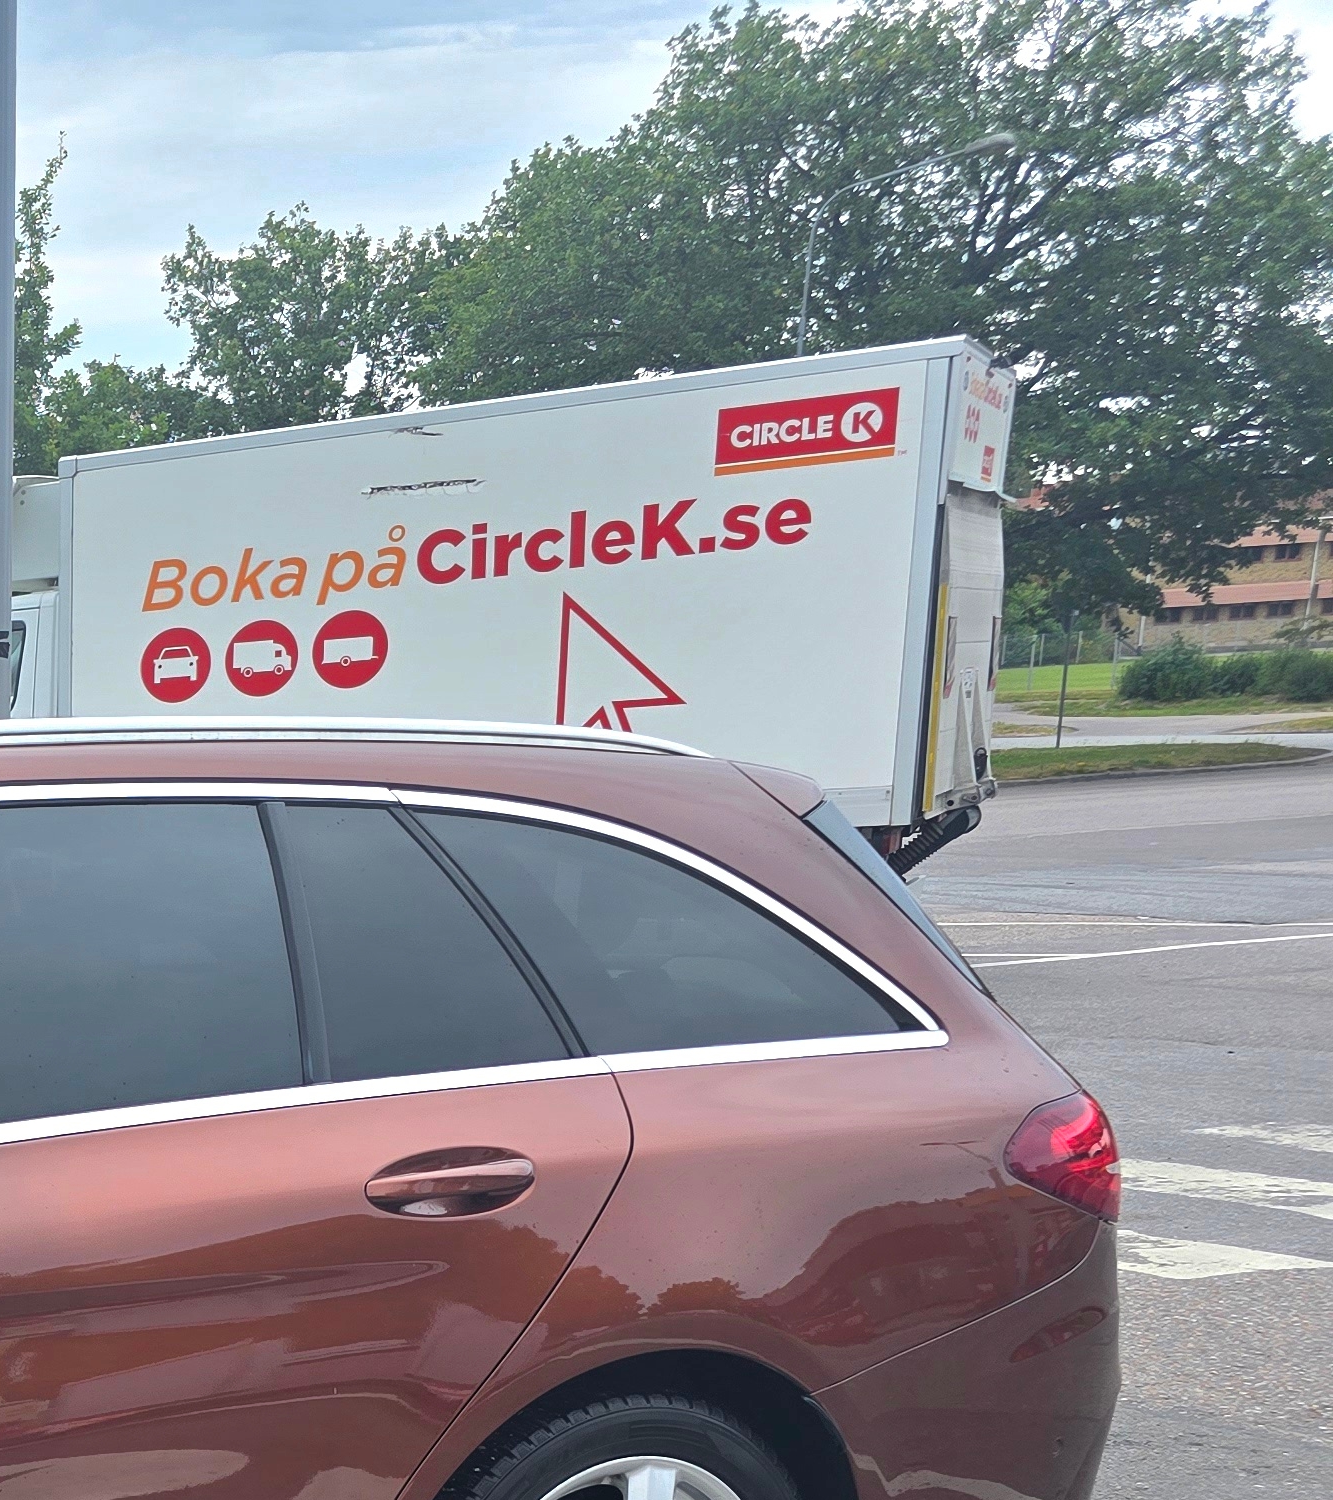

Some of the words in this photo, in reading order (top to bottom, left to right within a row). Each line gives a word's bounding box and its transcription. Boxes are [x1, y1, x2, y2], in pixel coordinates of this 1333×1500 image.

[730, 414, 834, 449] CIRCLE
[142, 547, 308, 612] Boka
[316, 524, 407, 606] på
[416, 498, 813, 586] CircleK.se
